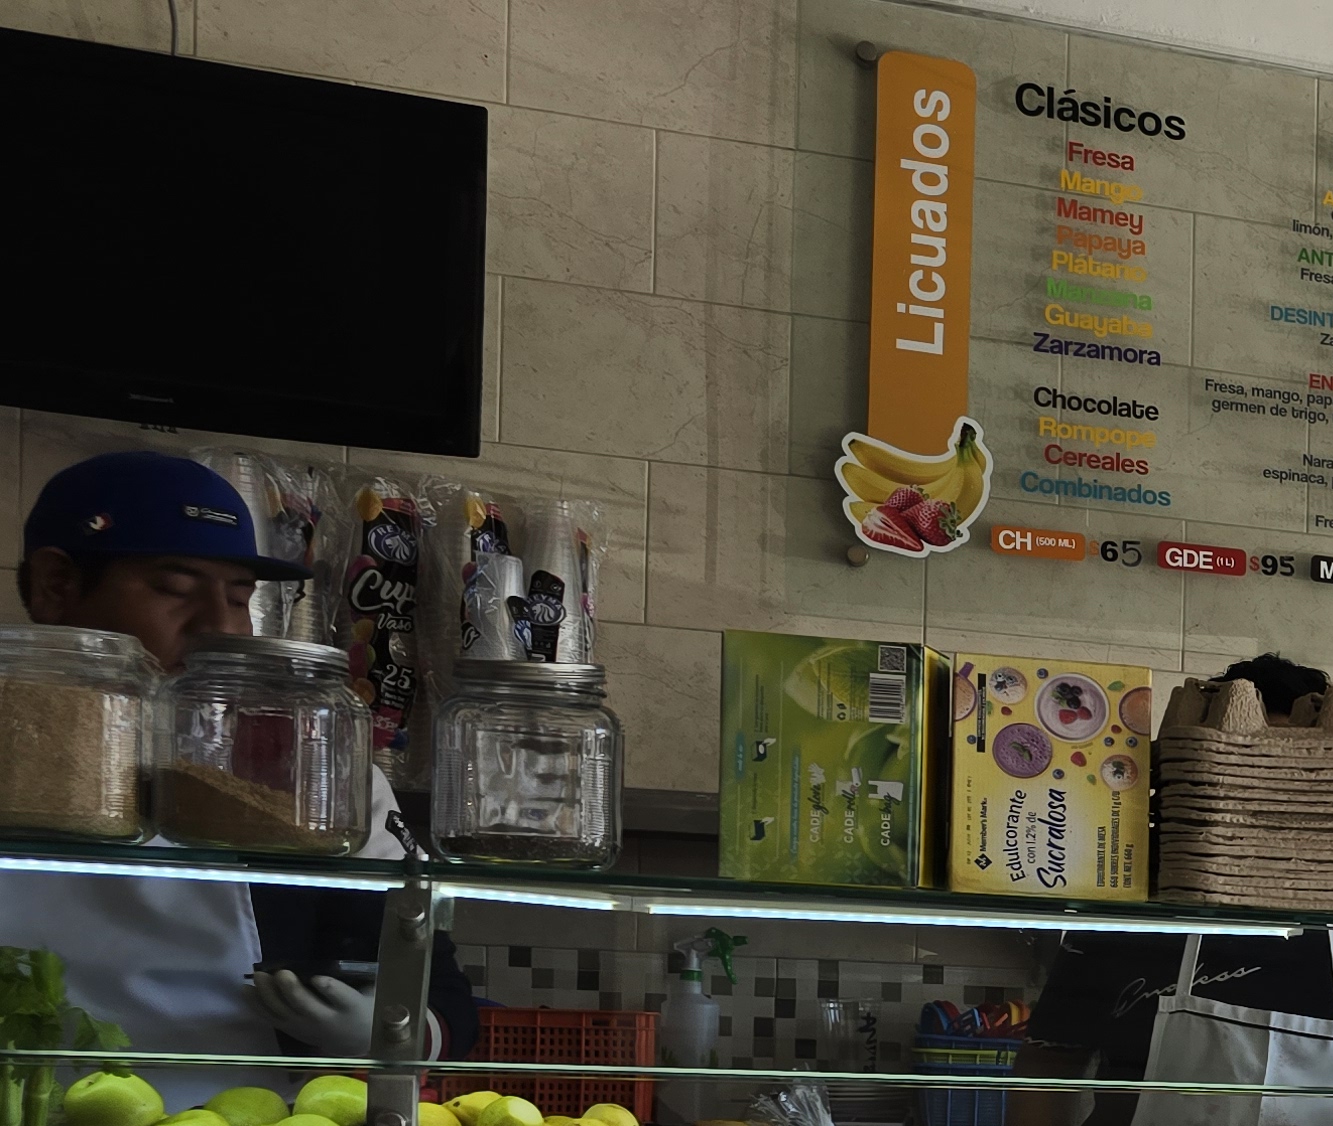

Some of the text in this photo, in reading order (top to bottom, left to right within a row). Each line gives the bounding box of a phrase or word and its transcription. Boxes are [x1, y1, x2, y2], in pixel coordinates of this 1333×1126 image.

[1014, 82, 1187, 141] Clásicos
[1067, 140, 1135, 172] Fresa
[1060, 168, 1143, 205] Mango
[895, 88, 951, 355] Licuados
[1056, 196, 1144, 235] Mamey
[1056, 224, 1147, 260] Papaya
[1051, 249, 1148, 283] Plátano
[1044, 303, 1153, 338] Guayaba
[1032, 331, 1161, 367] Zarzamora
[1033, 386, 1160, 421] Chocolate
[1204, 378, 1248, 397] Fresa,
[1211, 398, 1330, 424] germen trigo,
[1038, 416, 1158, 450] Rompope
[1043, 443, 1150, 476] Cereales
[1020, 470, 1172, 507] Combinados
[998, 528, 1032, 551] CH
[1165, 547, 1214, 570] GDE
[1250, 553, 1295, 577] $95
[1025, 811, 1036, 823] de
[1003, 789, 1027, 882] Edulcorante
[1036, 787, 1067, 889] Sucralosa
[1027, 846, 1036, 864] con
